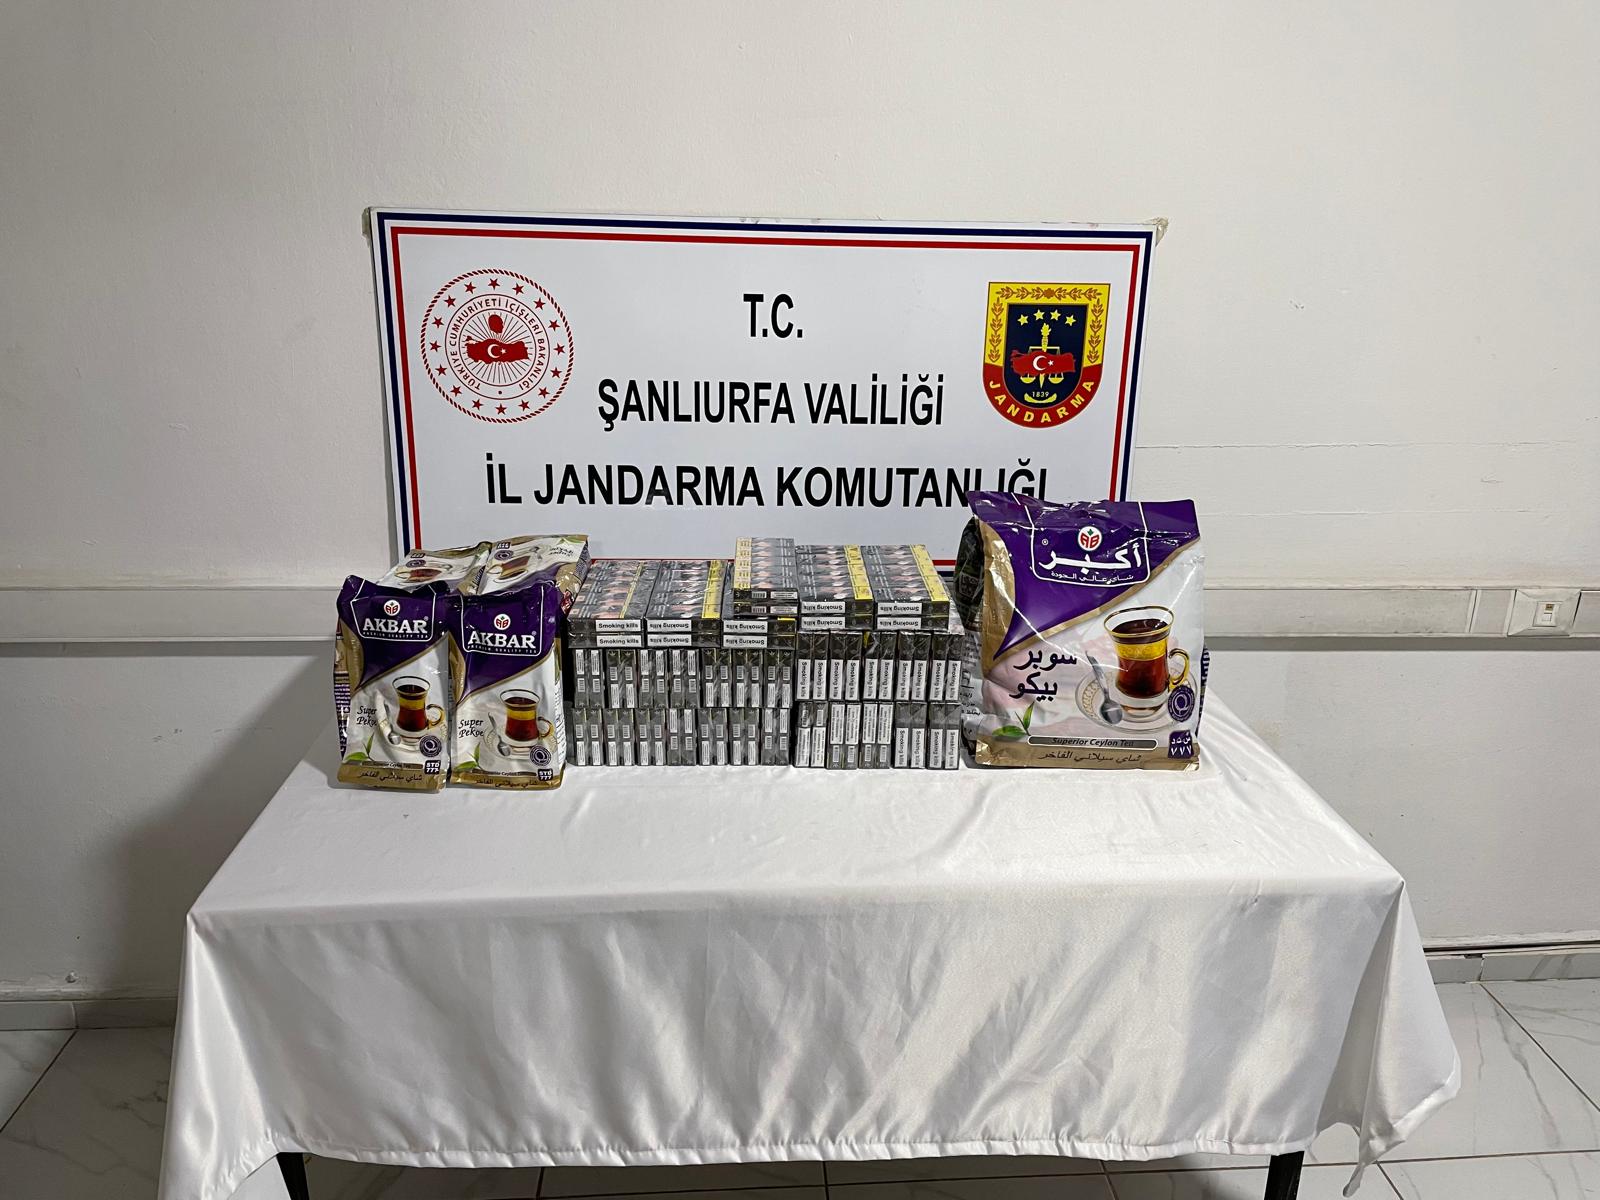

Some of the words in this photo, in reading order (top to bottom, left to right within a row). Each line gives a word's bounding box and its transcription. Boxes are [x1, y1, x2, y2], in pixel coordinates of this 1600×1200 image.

[449, 297, 501, 346] CUMHURİYETİ
[506, 299, 541, 335] İÇİŞLERİ
[743, 294, 803, 338] T.C.
[450, 351, 480, 390] TÜRKİYE
[519, 338, 545, 390] BAKANLIĞI
[598, 378, 795, 432] ŞANLIURFA
[804, 373, 944, 425] VALİLİĞİ
[989, 380, 1094, 423] JANDARMA
[486, 452, 522, 504] İL
[534, 464, 764, 506] JANDARMA
[1038, 542, 1142, 575] أكبر
[362, 618, 428, 634] AKBAR
[467, 631, 536, 649] AKBAR
[1013, 650, 1077, 671] سوبر
[1009, 671, 1058, 702] بيكو
[458, 719, 484, 729] Super
[458, 727, 484, 738] Pekoe
[1051, 737, 1088, 745] Superior
[1089, 738, 1118, 747] Ceylon
